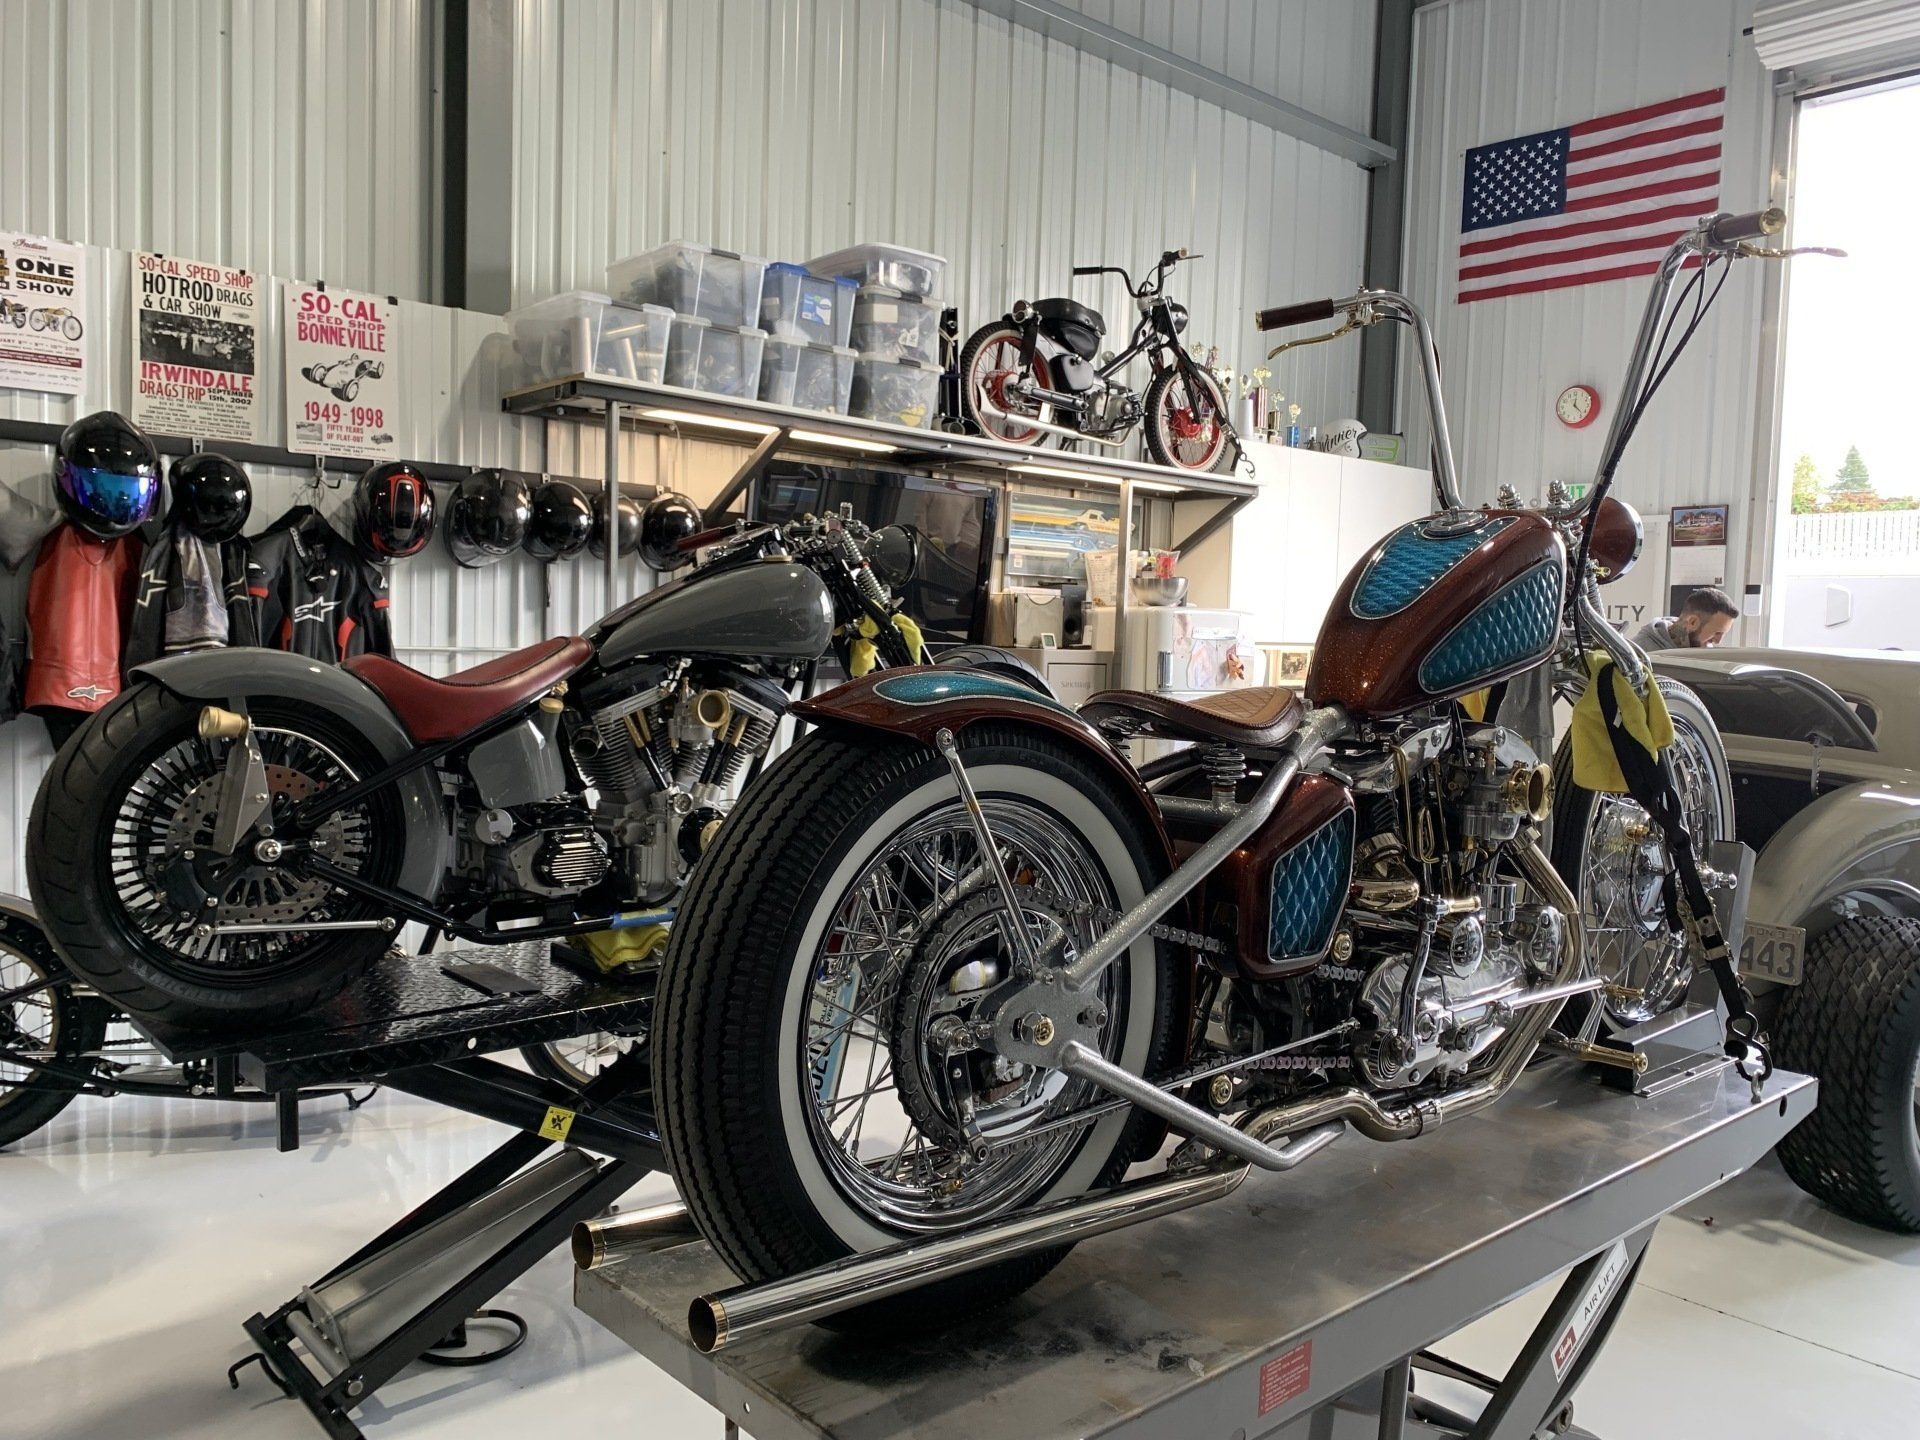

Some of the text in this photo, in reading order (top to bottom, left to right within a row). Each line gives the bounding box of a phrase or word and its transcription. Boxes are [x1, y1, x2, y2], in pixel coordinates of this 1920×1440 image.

[16, 258, 74, 278] ONE
[139, 256, 253, 289] SO-CAL SPEED SHOP
[16, 280, 73, 296] SHOW
[143, 272, 254, 306] HOTROD DRAGS
[143, 294, 222, 319] & CAR SHOW
[301, 292, 382, 322] SO-CAL
[297, 312, 386, 332] SPEED SHOP
[298, 322, 386, 352] BONNEVILLE
[142, 362, 252, 392] IRWINDALE
[140, 380, 206, 401] DRAGSTRIP
[207, 387, 254, 399] SEPTEMBER
[230, 397, 252, 405] 2002
[345, 425, 364, 434] YEARS
[1318, 428, 1357, 453] Winner
[1568, 485, 1585, 498] IT
[1739, 936, 1795, 977] 443
[826, 988, 838, 1022] VEHCLE
[1584, 1262, 1615, 1320] AIR LIFT
